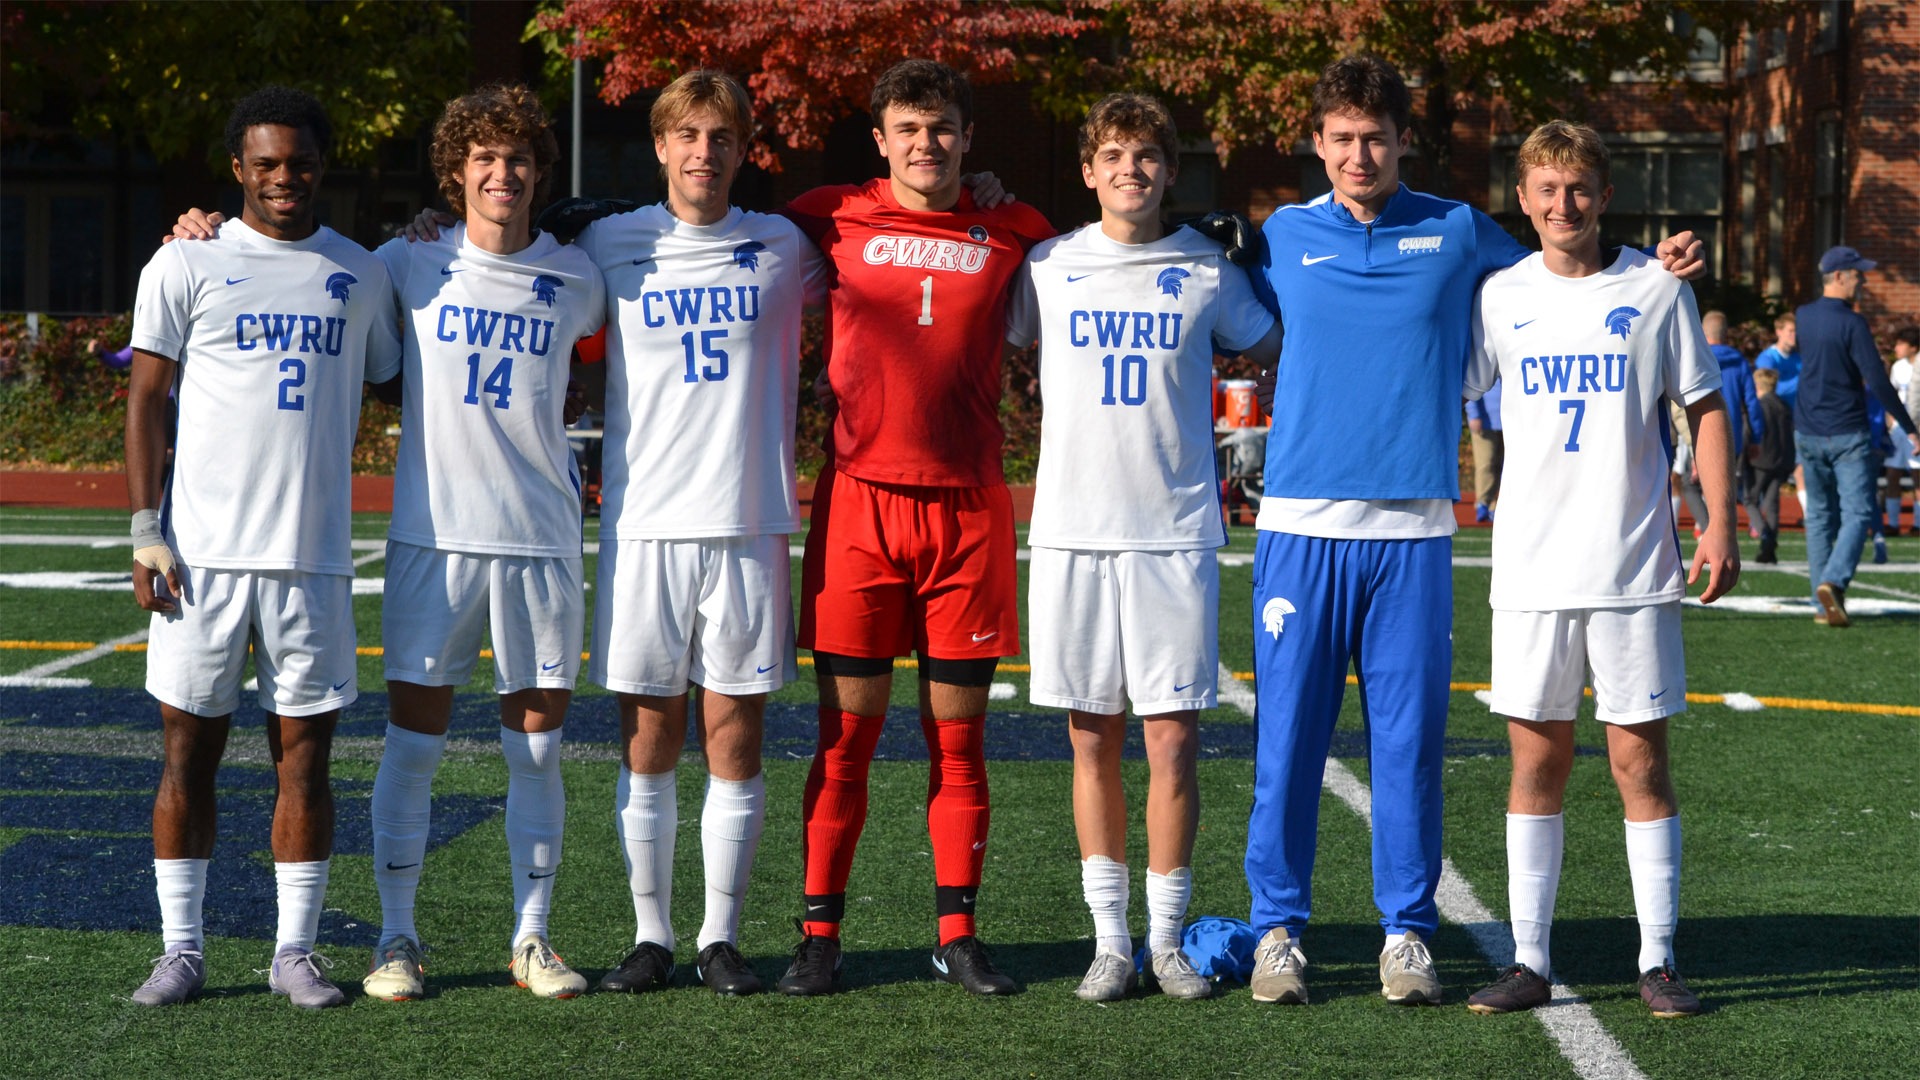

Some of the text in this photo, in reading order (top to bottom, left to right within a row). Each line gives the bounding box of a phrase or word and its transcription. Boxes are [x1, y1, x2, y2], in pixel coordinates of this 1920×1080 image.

[863, 235, 992, 274] CWRU
[1398, 236, 1443, 250] CWRU
[643, 286, 759, 328] CWRU
[918, 275, 933, 326] 1
[237, 314, 346, 357] CWRU
[437, 305, 554, 356] CWRU
[1071, 311, 1183, 350] CWRU
[464, 353, 512, 410] 14
[682, 330, 729, 384] 15
[1102, 355, 1147, 406] 10
[1522, 355, 1627, 395] CWRU
[278, 359, 306, 411] 2
[1559, 400, 1585, 452] 7
